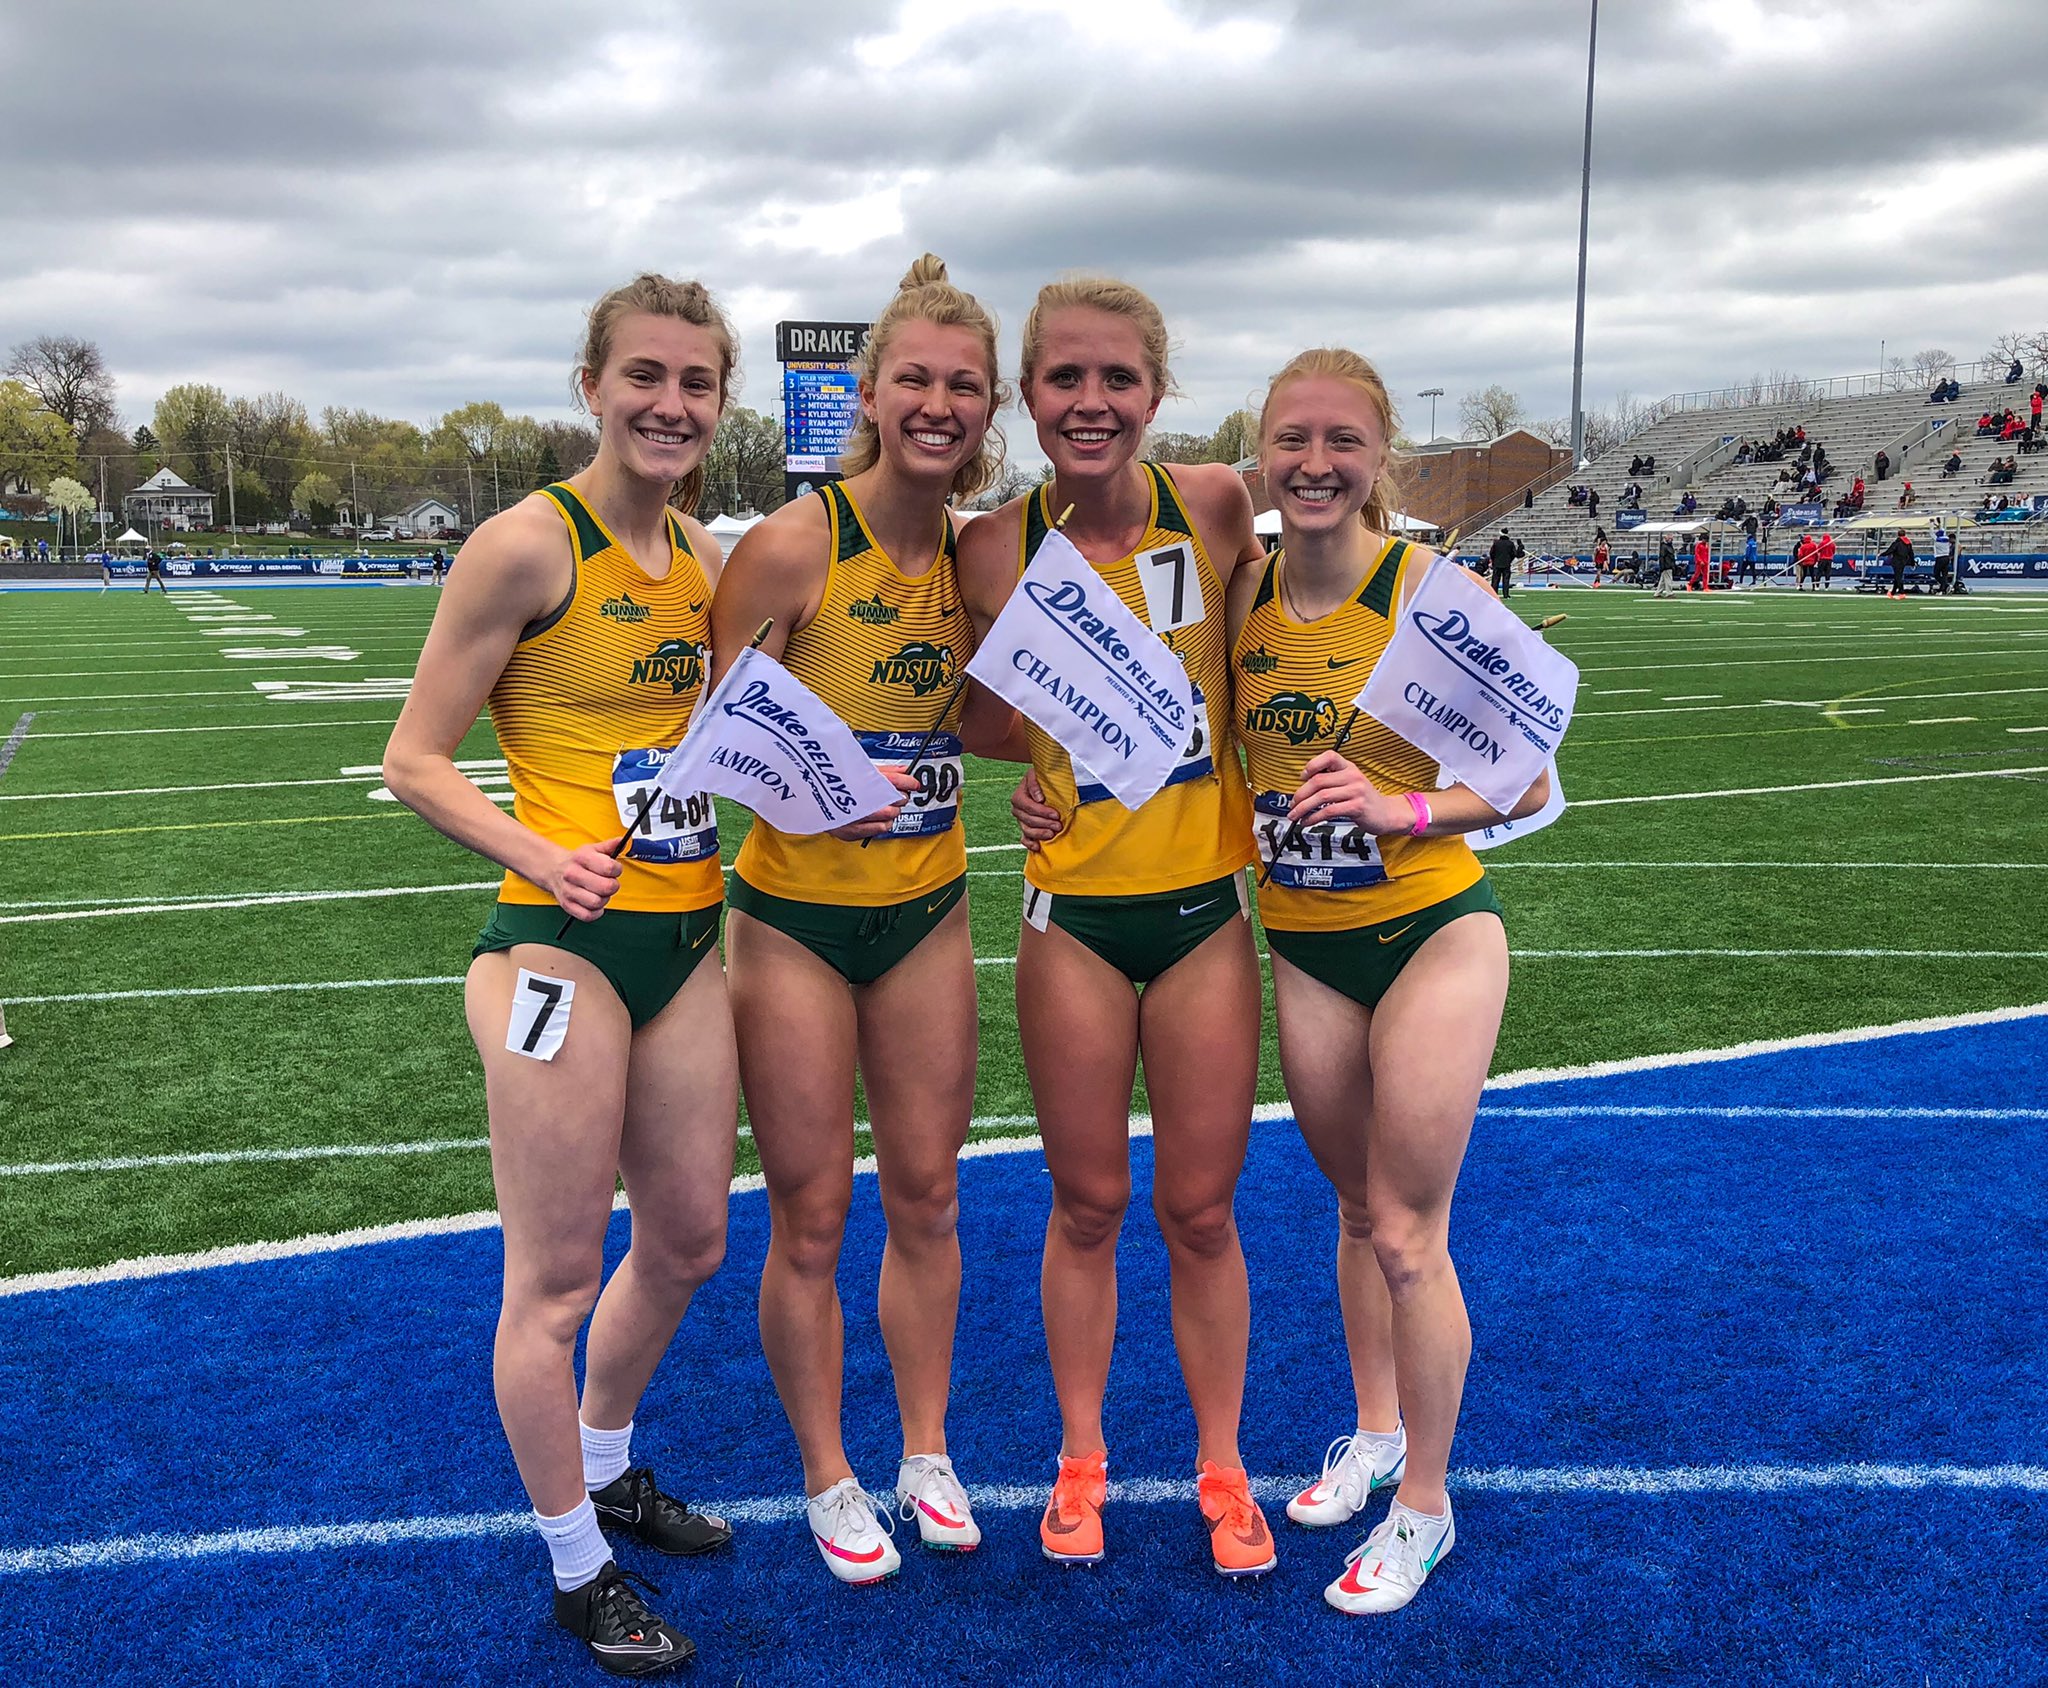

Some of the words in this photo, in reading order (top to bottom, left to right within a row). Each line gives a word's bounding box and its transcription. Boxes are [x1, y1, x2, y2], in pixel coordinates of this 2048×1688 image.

[790, 328, 855, 353] DRAKE
[786, 361, 824, 369] UNIVERSITY
[825, 362, 845, 370] MEN'S
[788, 378, 795, 389] 3
[808, 401, 839, 409] MITCHELL
[808, 419, 827, 427] RYAN
[828, 419, 848, 427] SMITH
[808, 428, 834, 436] STEVON
[808, 437, 823, 445] LEVI
[808, 445, 837, 453] WILLIAM
[165, 561, 196, 572] Smart
[1980, 562, 2025, 570] XTREAM
[1150, 547, 1186, 625] 7
[600, 603, 651, 617] SUMMIT
[848, 604, 900, 619] SUMMIT
[1043, 580, 1130, 662] Drake
[1125, 659, 1186, 722] RELAYS
[628, 658, 696, 684] NDSU
[867, 659, 939, 684] NDSU
[1431, 610, 1511, 676] Drake
[1501, 671, 1564, 726] RELAYS
[1104, 675, 1131, 700] PRESENTED
[1127, 696, 1136, 705] BY
[1478, 689, 1502, 710] PRESENTED
[1012, 648, 1139, 761] CHAMPION
[1143, 713, 1177, 748] XTREAM
[1245, 708, 1314, 734] NDSU
[1404, 681, 1507, 766] CHAMPION
[738, 680, 809, 737] Drake
[799, 739, 857, 808] RELAYS
[884, 732, 921, 747] Drake
[1516, 720, 1551, 751] XTREAM
[647, 748, 673, 766] Dra
[709, 746, 797, 801] AMPION
[908, 762, 960, 807] 90
[897, 813, 924, 822] USATF
[1306, 867, 1334, 876] USATF
[521, 977, 563, 1053] 7
